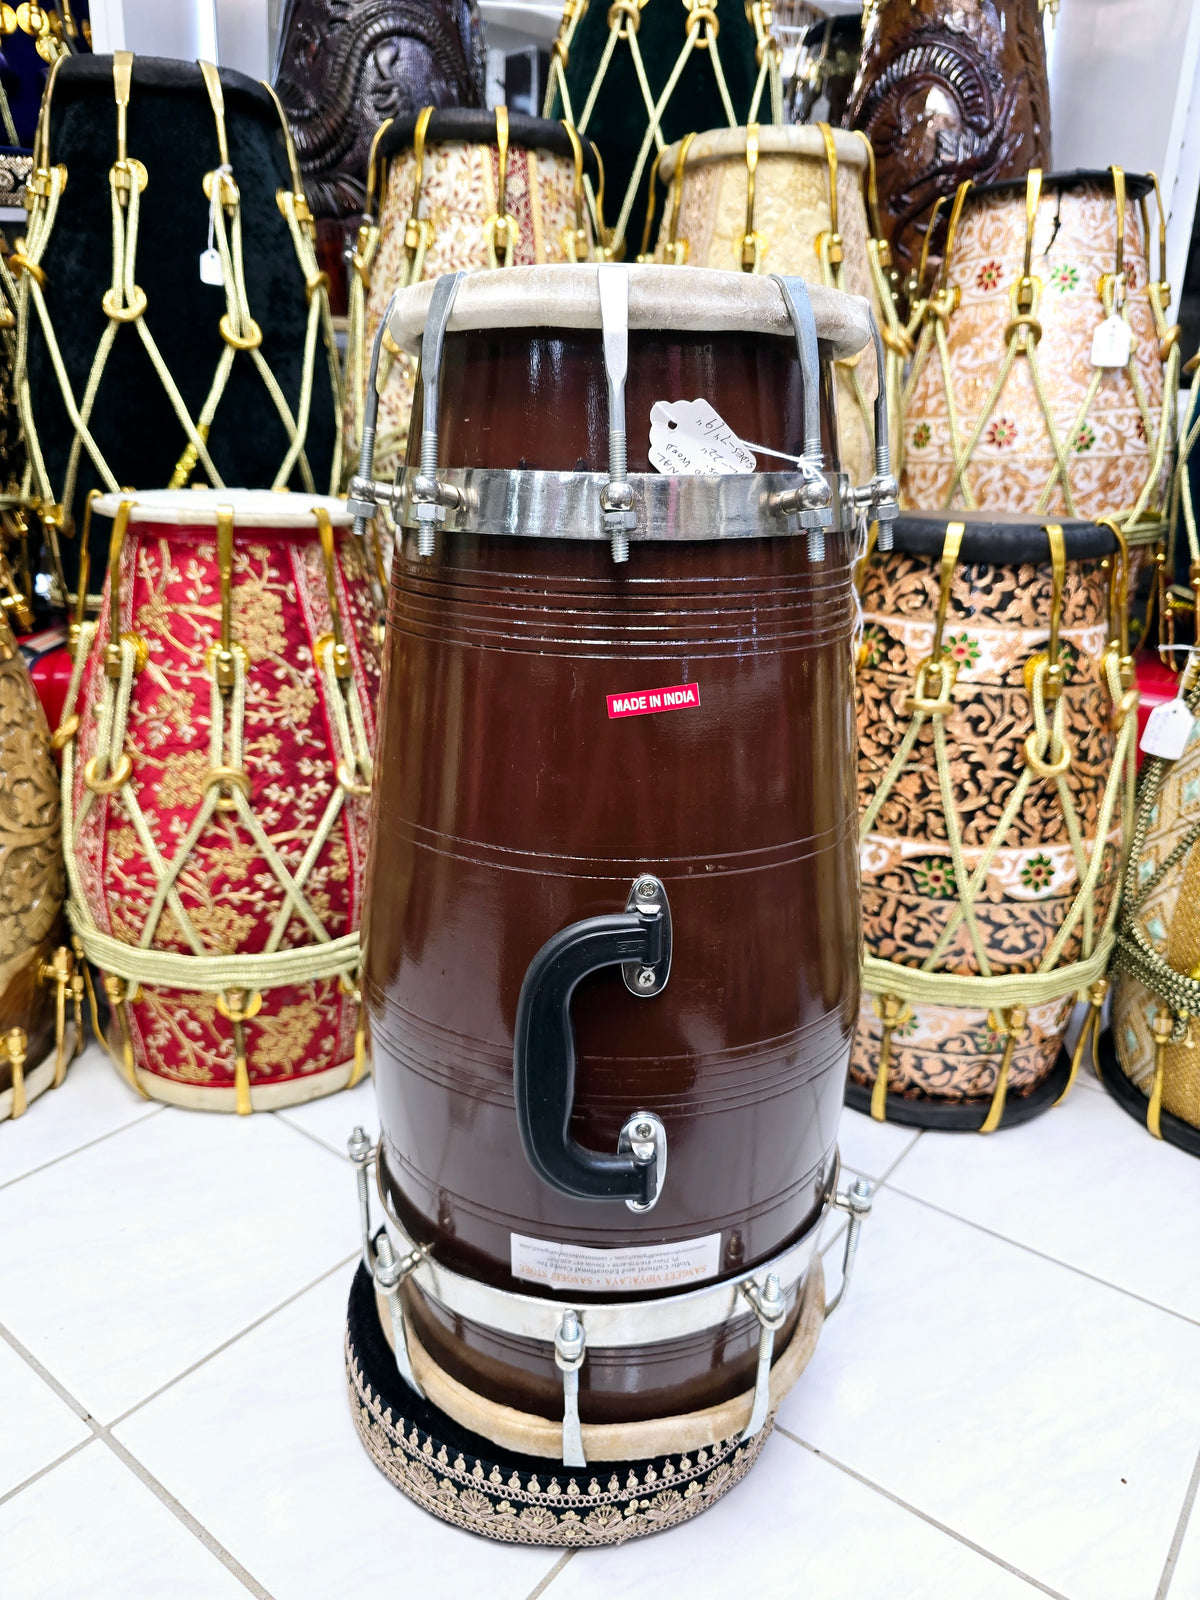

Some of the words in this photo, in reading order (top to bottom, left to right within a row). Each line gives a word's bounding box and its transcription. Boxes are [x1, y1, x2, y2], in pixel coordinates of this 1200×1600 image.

[613, 697, 647, 712] MADE
[650, 694, 661, 707] IN
[663, 690, 695, 706] INDIA
[575, 1266, 620, 1274] Educational
[621, 1266, 636, 1274] and
[638, 1264, 670, 1273] Cultural
[671, 1260, 692, 1269] Vedic
[520, 1264, 548, 1278] STORE
[665, 1264, 707, 1281] SANGEET
[606, 1273, 662, 1286] VIDYALAYA
